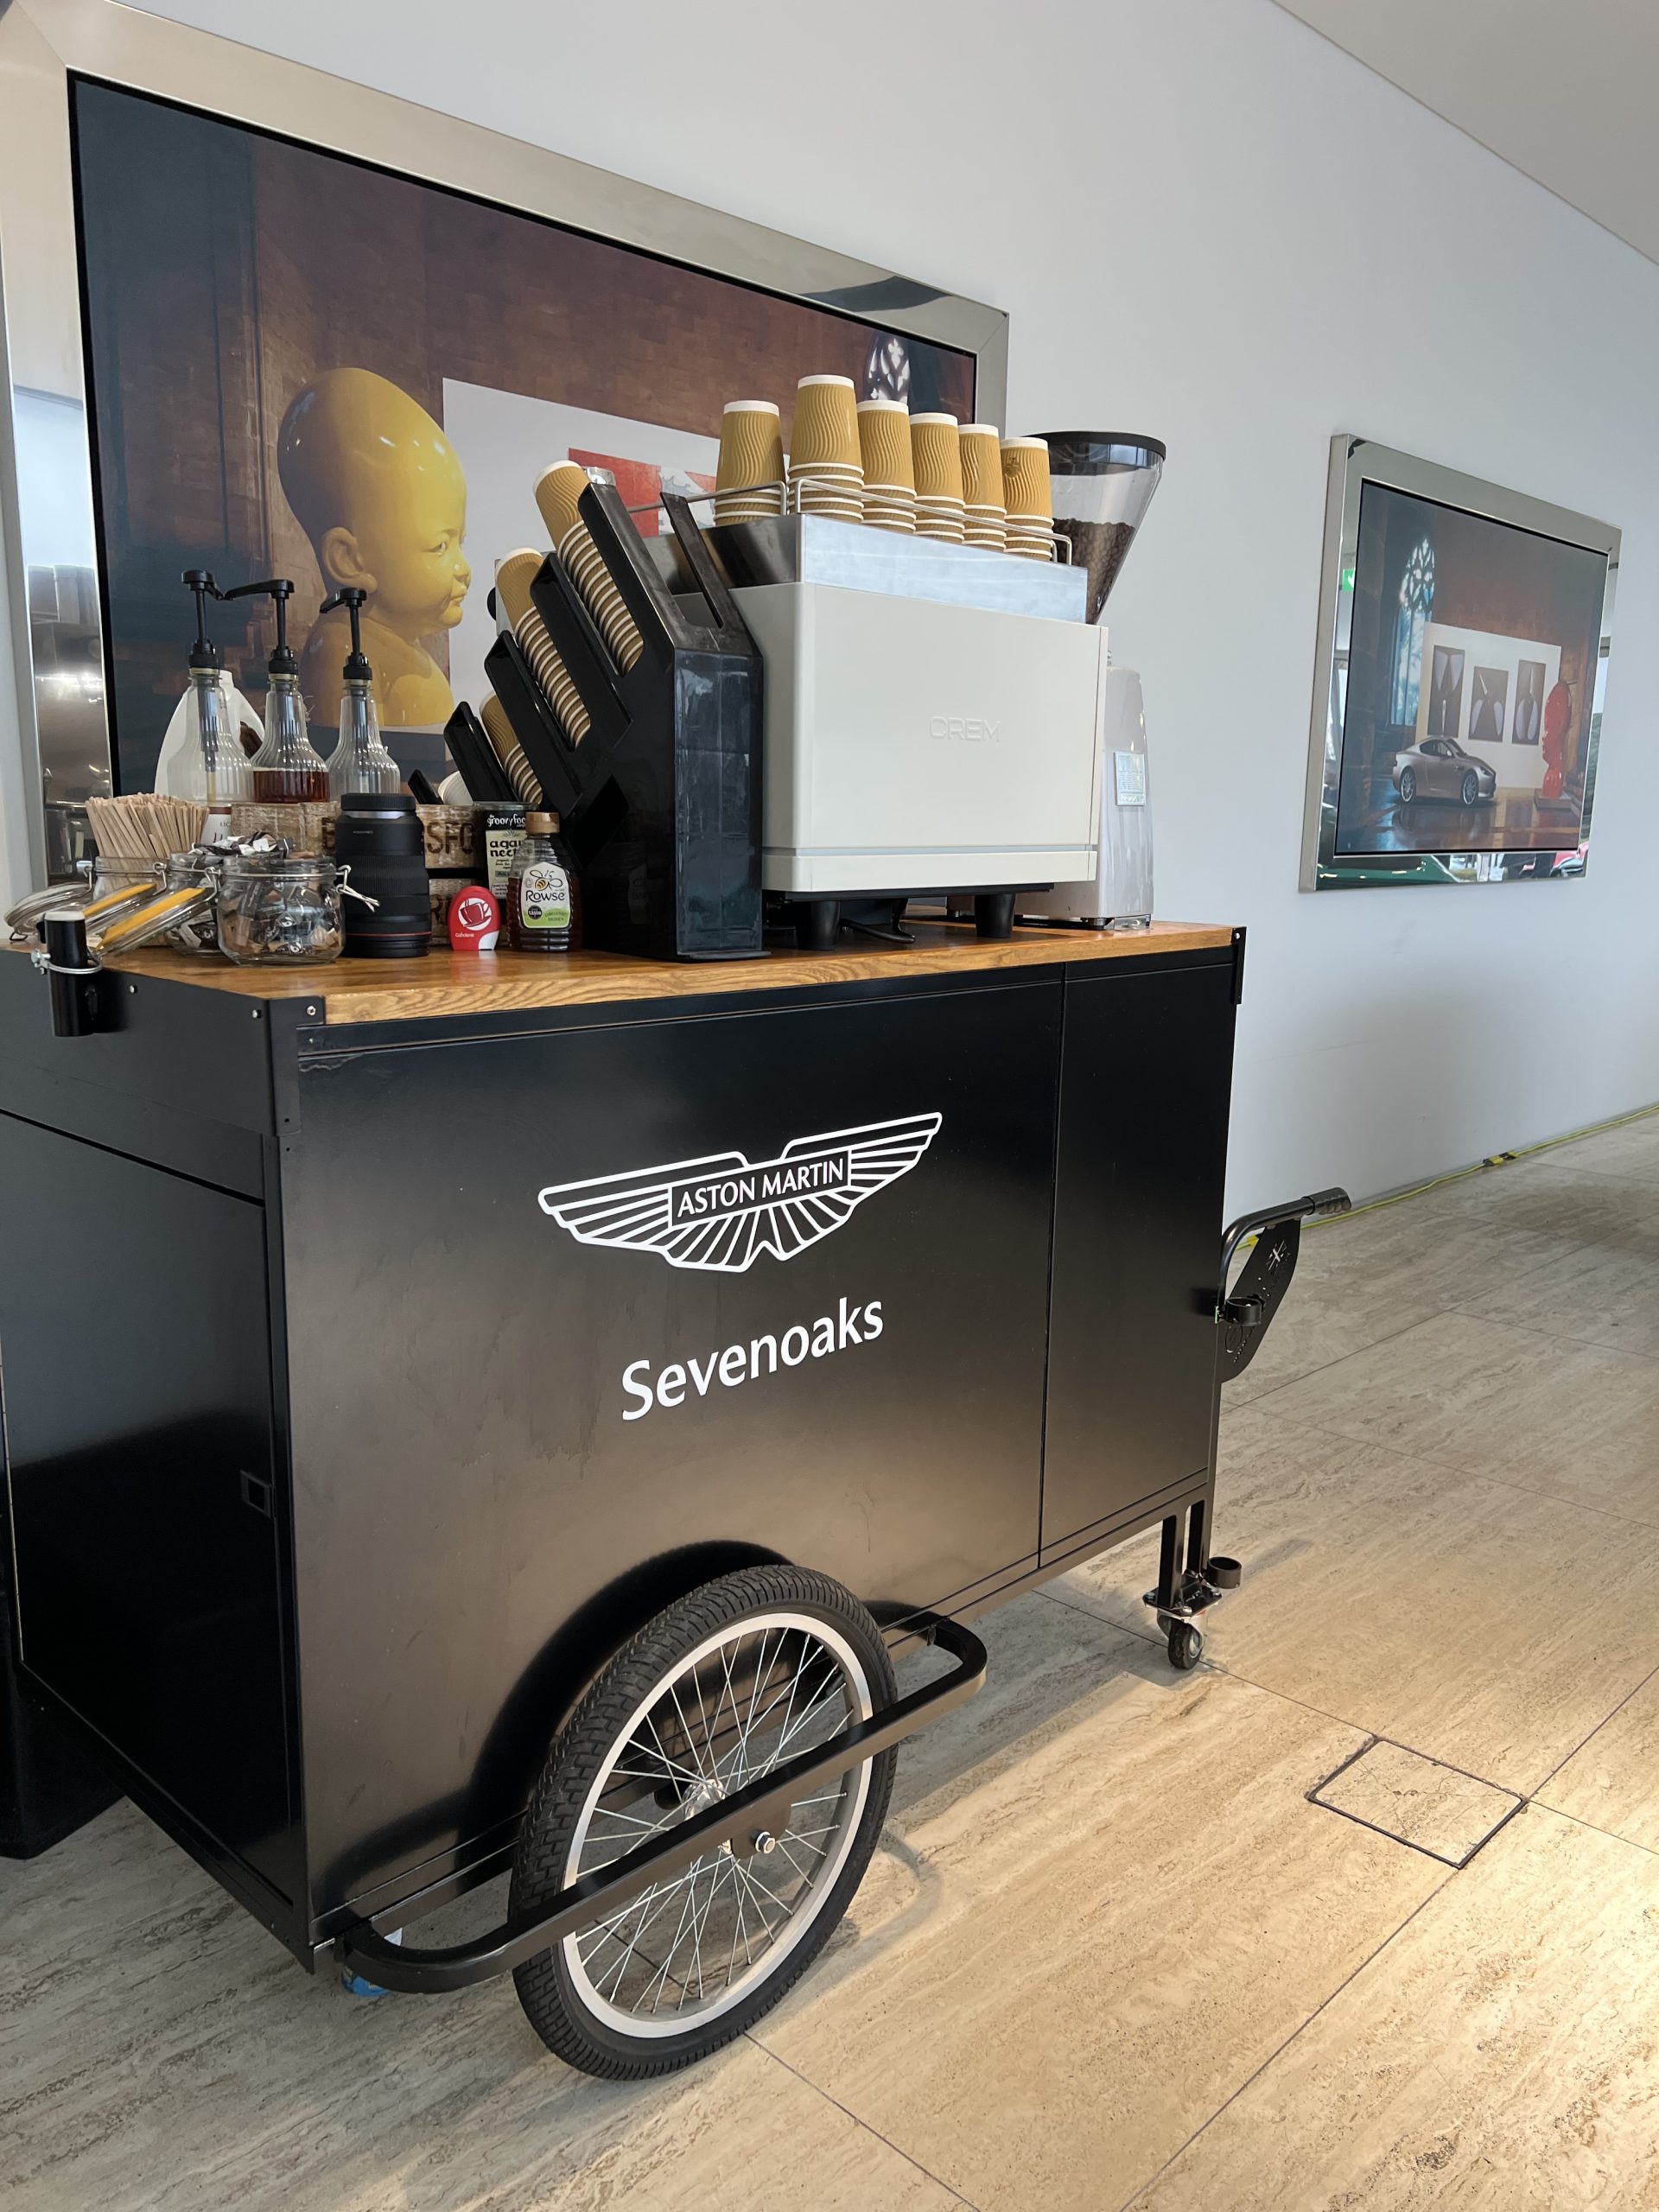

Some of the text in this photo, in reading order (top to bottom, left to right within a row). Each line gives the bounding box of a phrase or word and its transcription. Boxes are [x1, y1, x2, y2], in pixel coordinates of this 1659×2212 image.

[930, 715, 1001, 742] CREM
[490, 840, 522, 849] aga
[525, 890, 565, 902] Rowse
[677, 1158, 844, 1218] ASTON MARTIN
[621, 1297, 884, 1421] Sevenoaks
